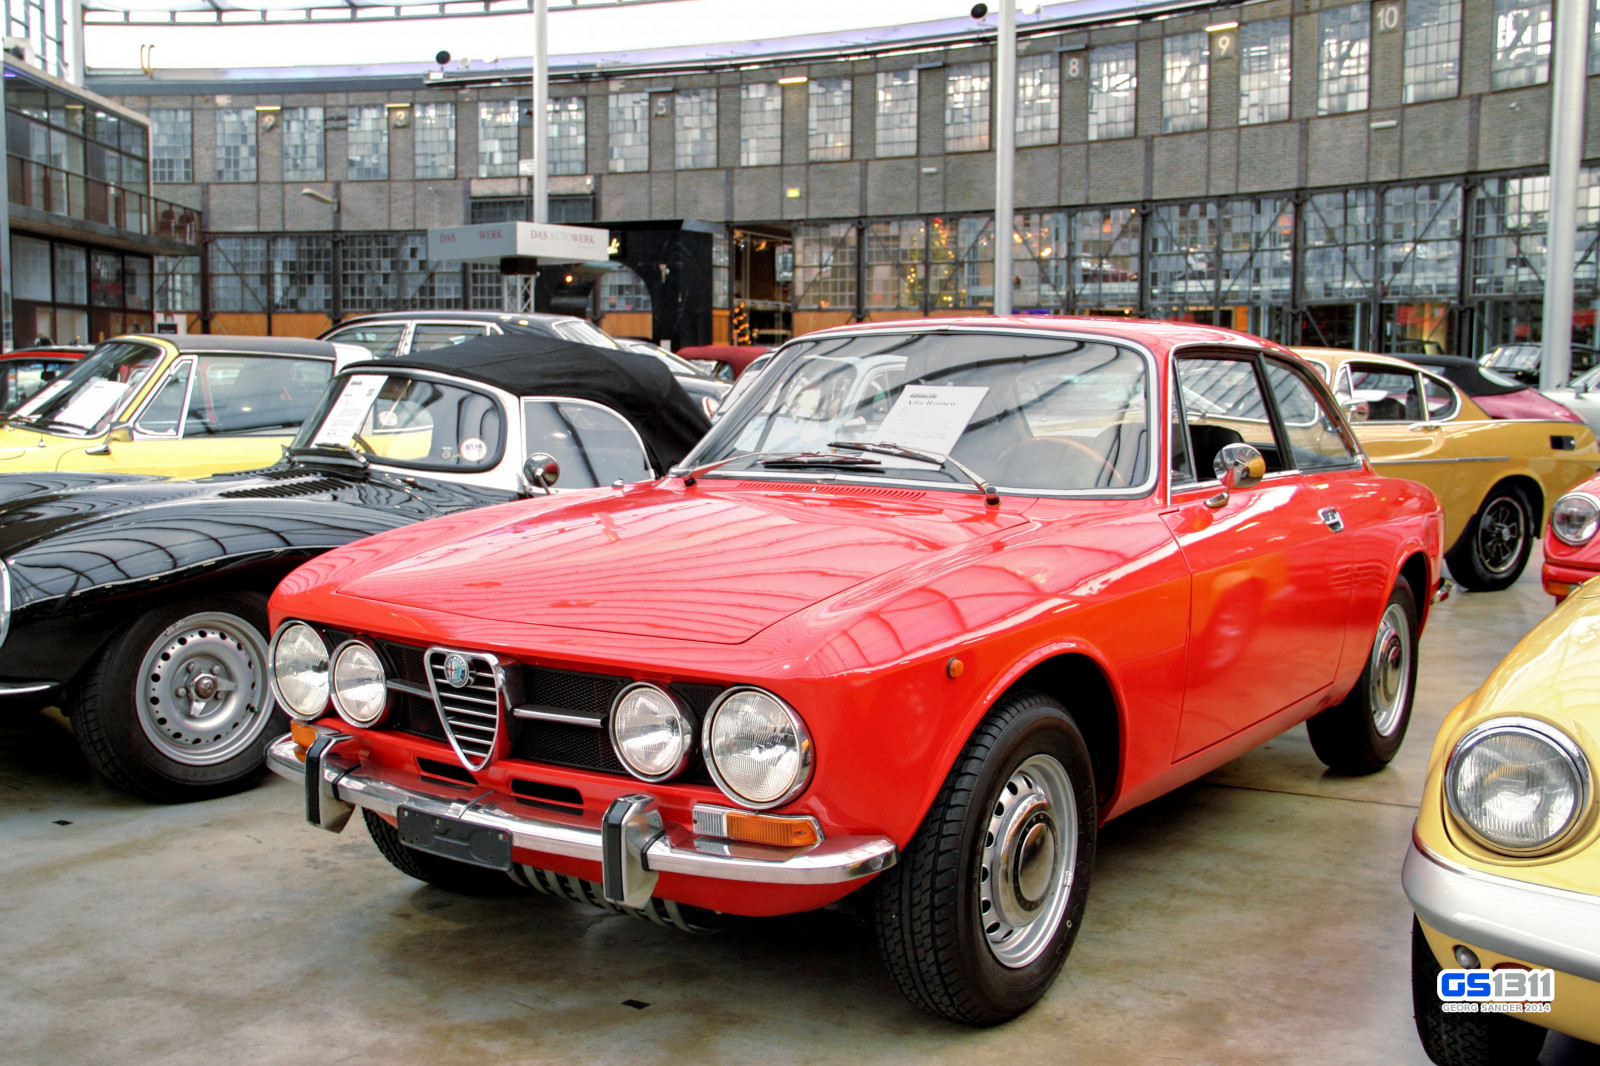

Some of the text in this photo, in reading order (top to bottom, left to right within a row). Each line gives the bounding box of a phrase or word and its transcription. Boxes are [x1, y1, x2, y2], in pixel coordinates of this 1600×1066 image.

[1376, 5, 1399, 30] 10
[1218, 36, 1230, 56] 9
[1069, 57, 1080, 77] 8
[657, 97, 667, 115] 5
[440, 233, 456, 243] DAS
[530, 230, 548, 241] DAS
